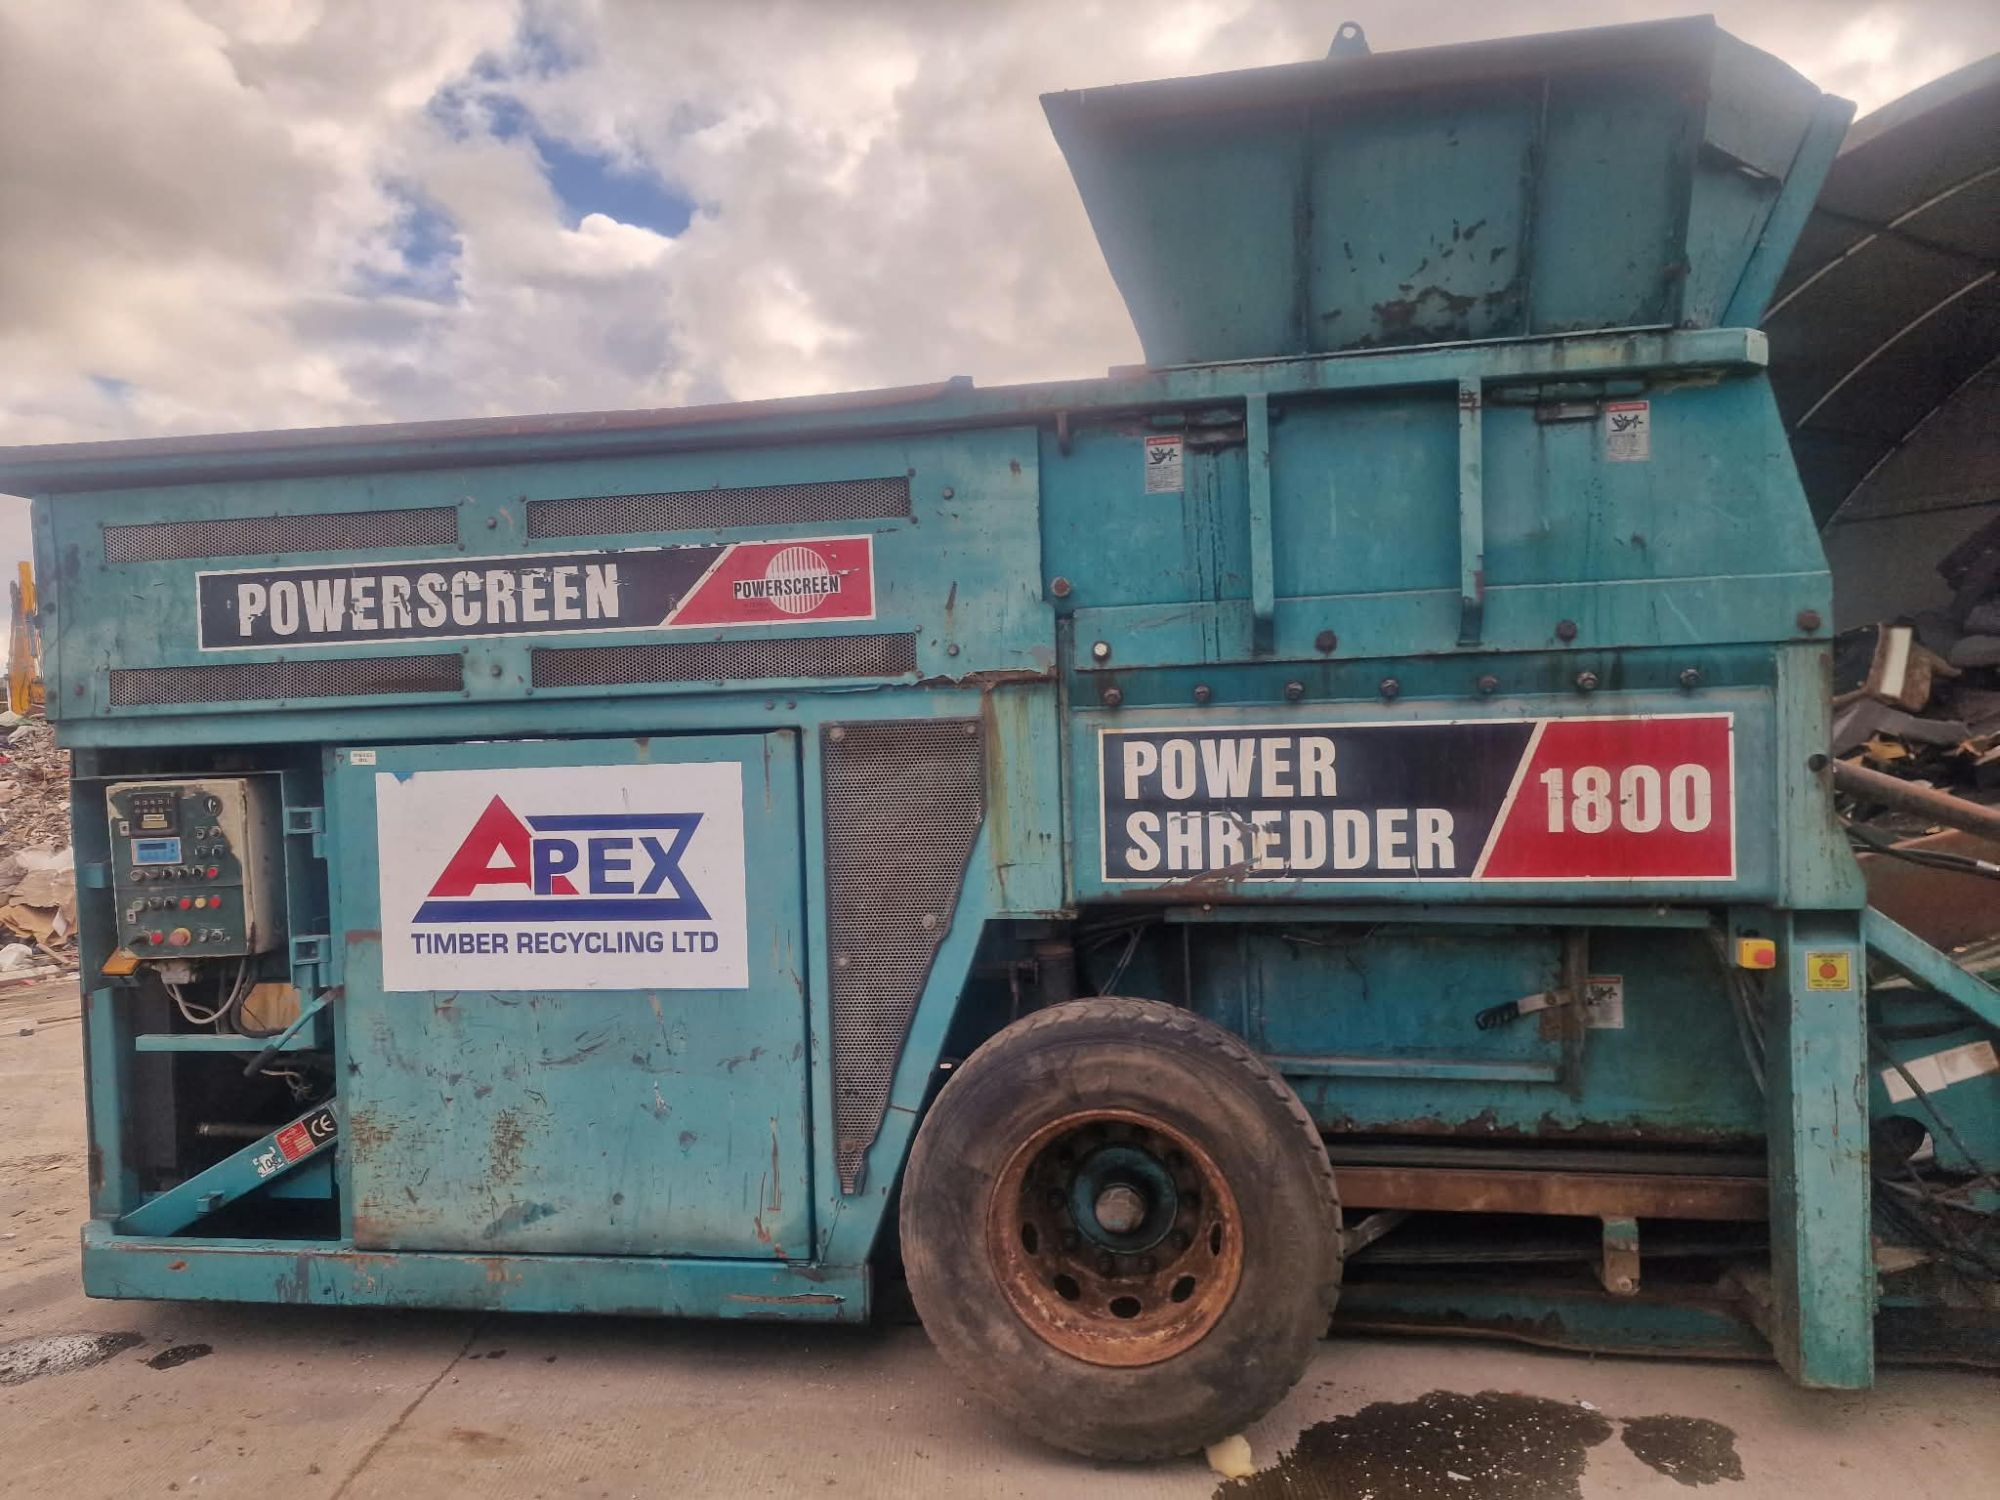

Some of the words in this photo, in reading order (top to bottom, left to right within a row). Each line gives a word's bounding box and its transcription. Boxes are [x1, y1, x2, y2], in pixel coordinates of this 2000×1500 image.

[237, 563, 619, 637] POWERSCREEN
[733, 575, 840, 599] POWERSCREEN
[1123, 737, 1337, 799] POWER
[1540, 764, 1712, 833] 1800
[427, 793, 703, 896] APEX
[1125, 809, 1455, 872] SHREDDER
[411, 933, 508, 955] TIMBER
[516, 932, 664, 953] RECYCLING
[672, 931, 718, 953] LTD
[311, 1114, 335, 1137] CE
